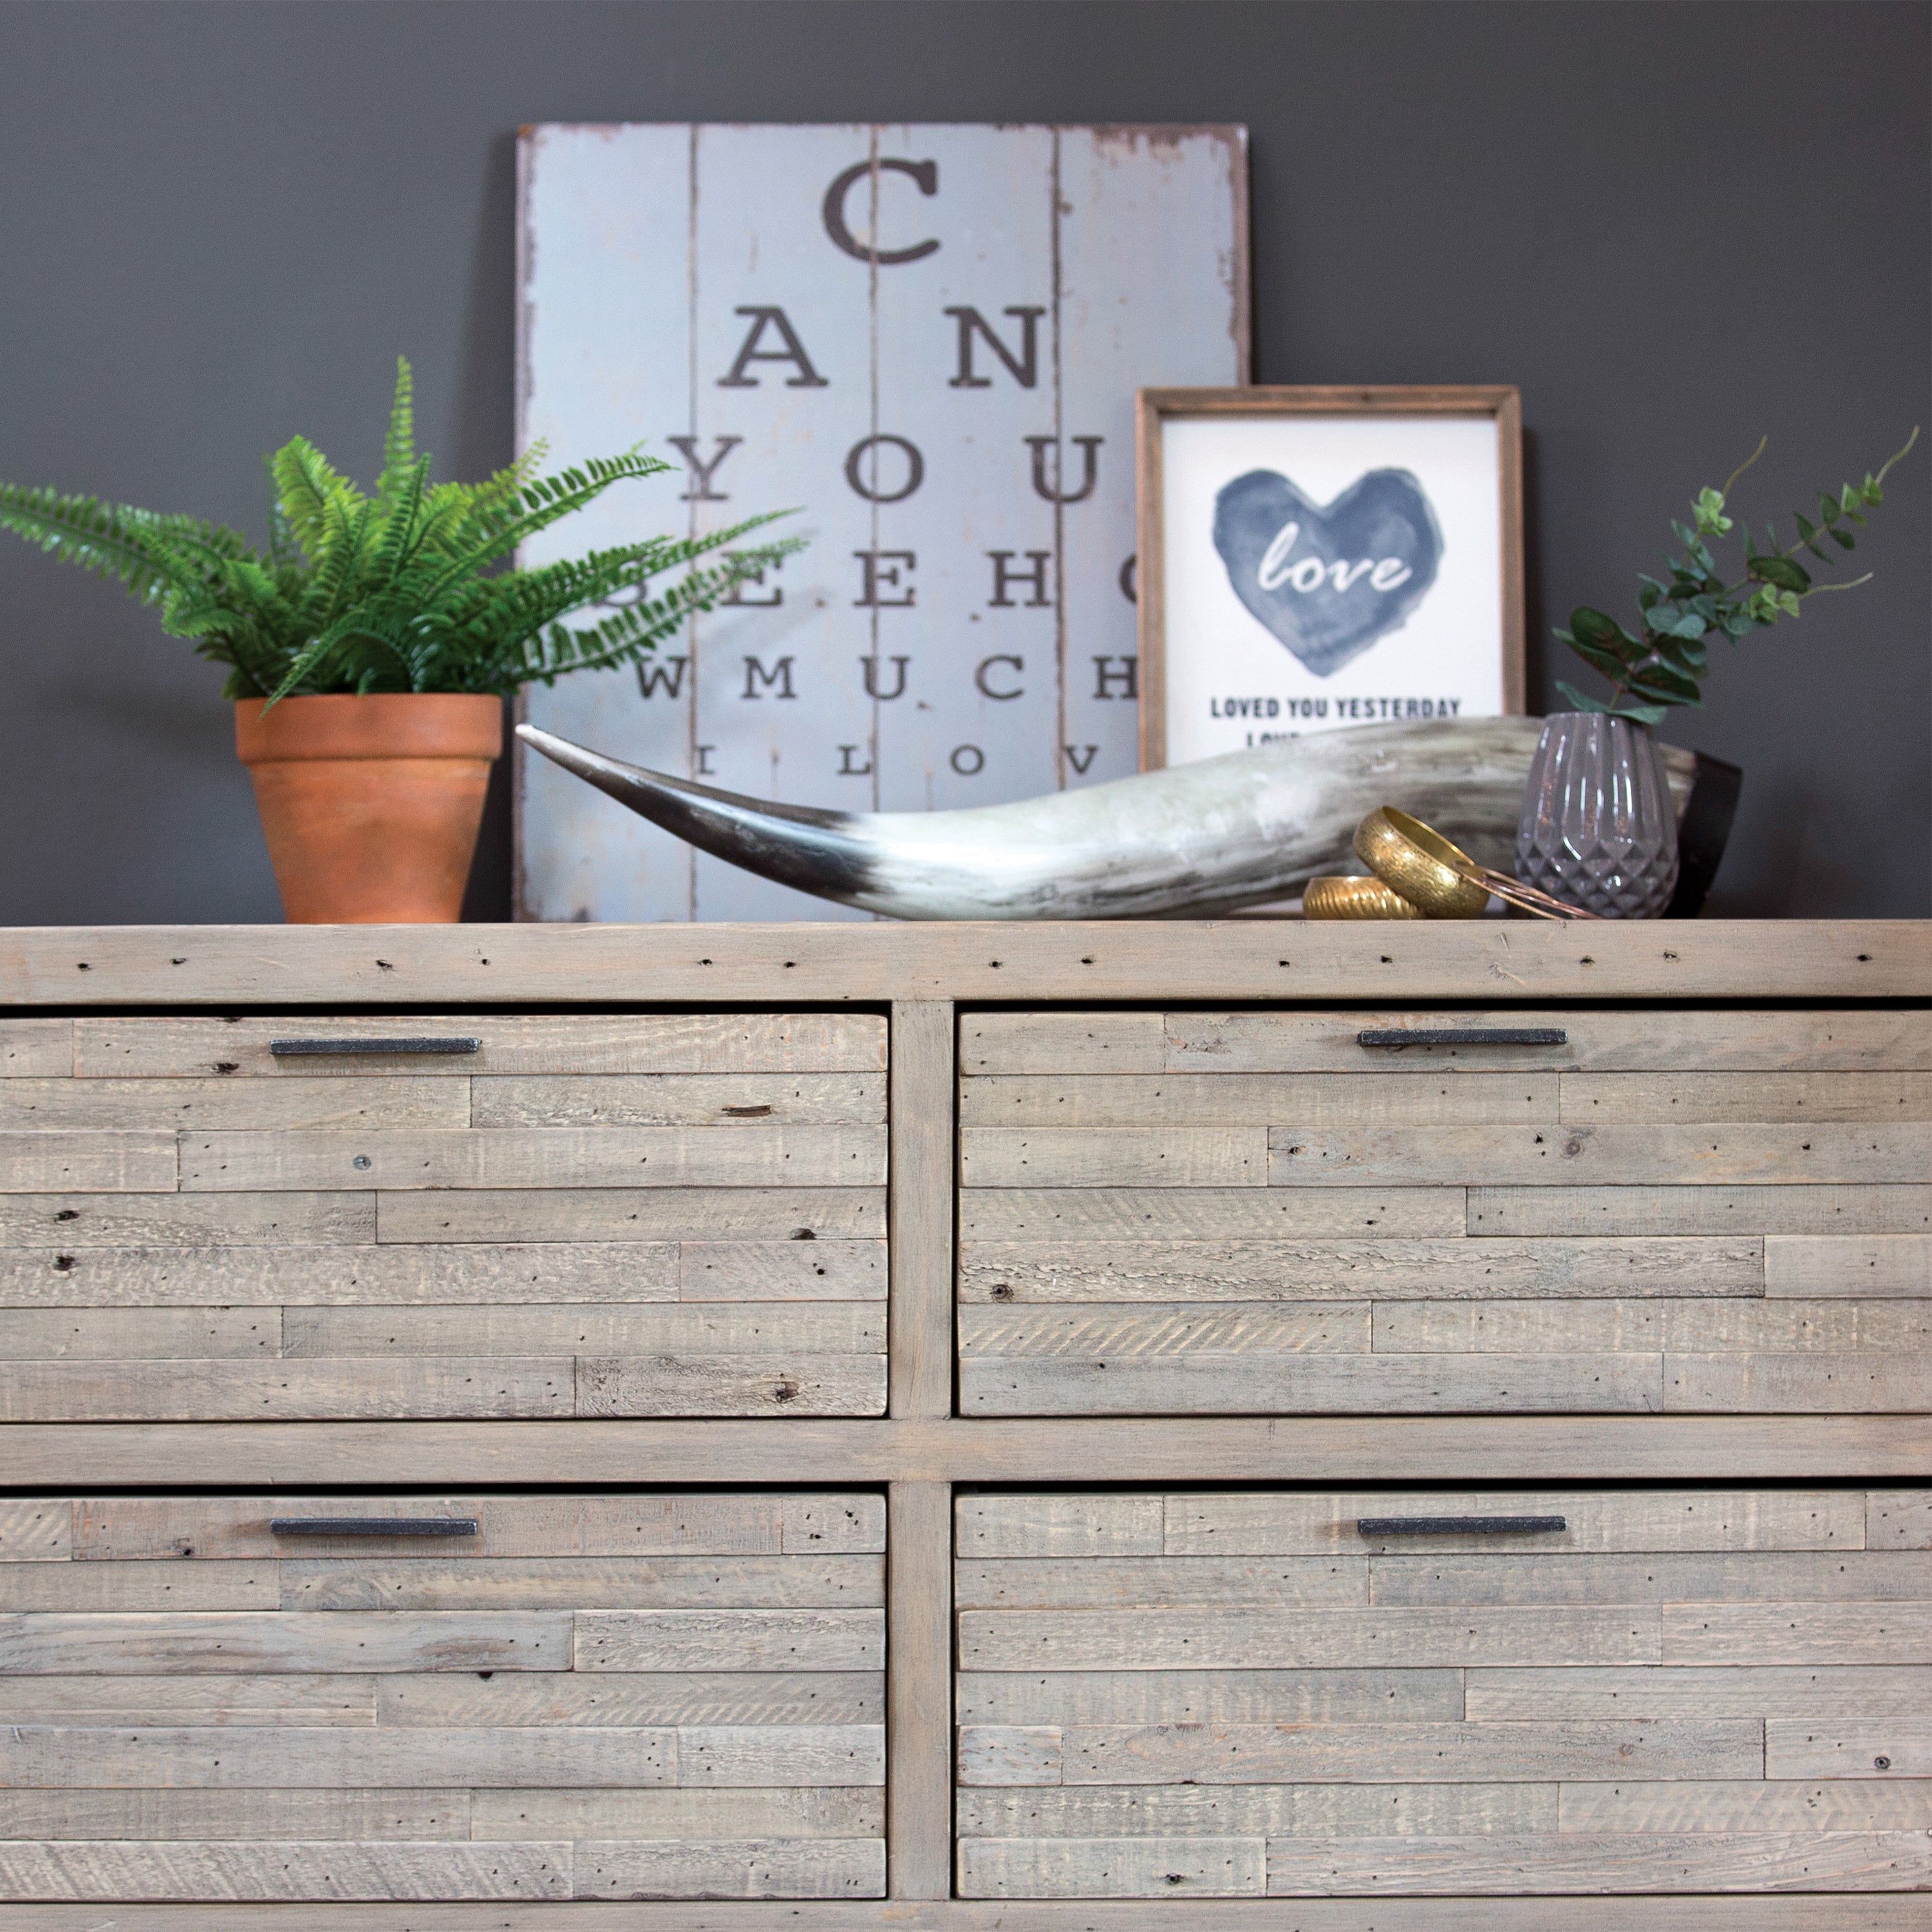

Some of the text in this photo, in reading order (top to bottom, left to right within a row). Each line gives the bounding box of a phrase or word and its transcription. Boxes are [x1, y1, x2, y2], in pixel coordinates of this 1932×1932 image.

[1257, 521, 1414, 592] love
[1211, 697, 1461, 719] LOVED YOU YESTERDAY
